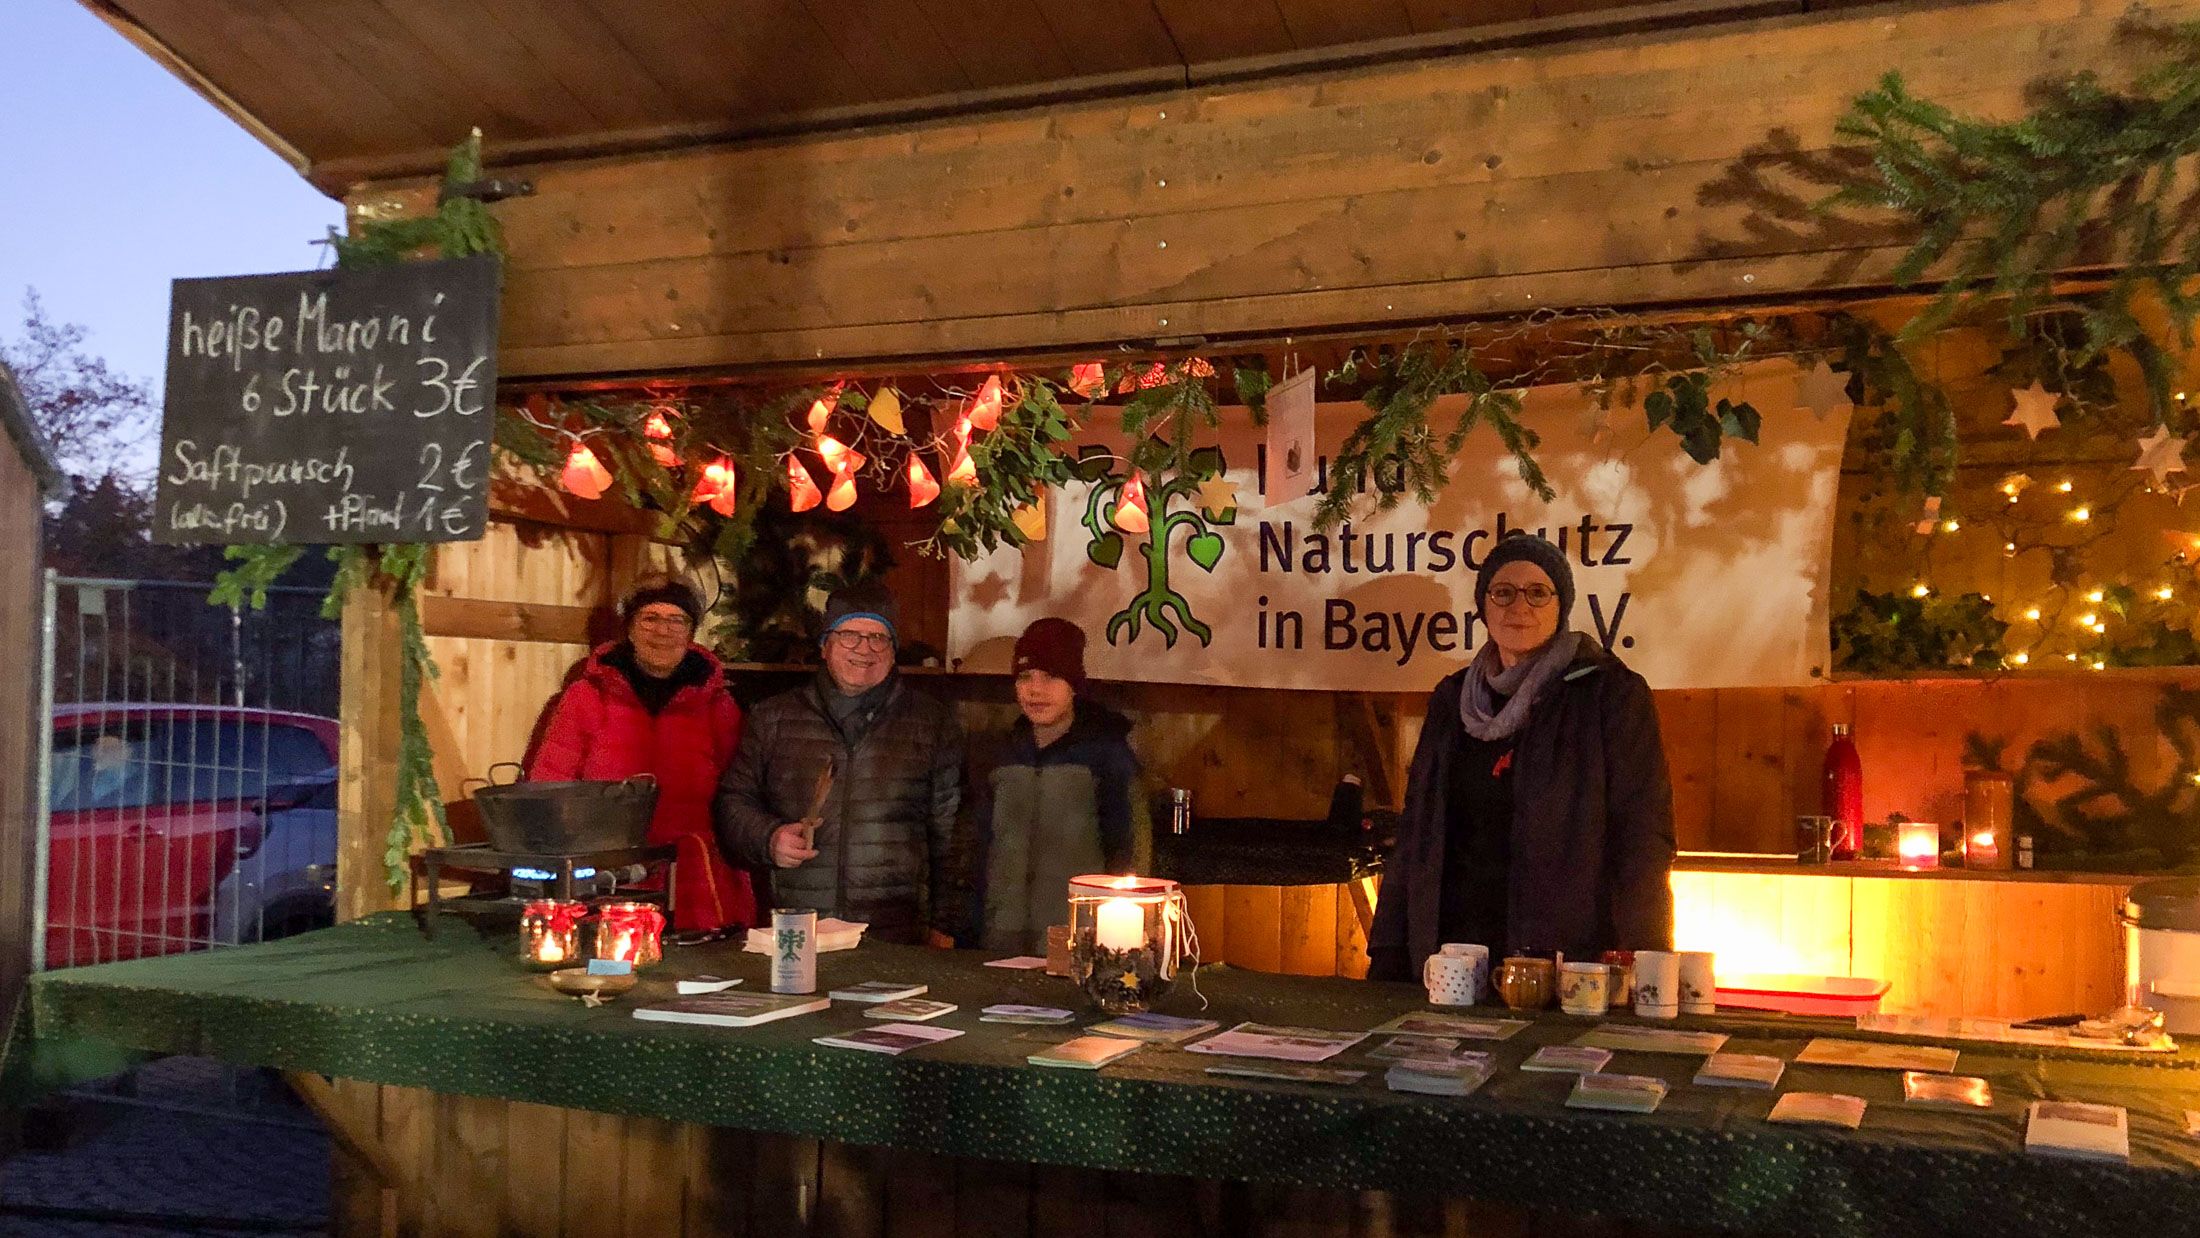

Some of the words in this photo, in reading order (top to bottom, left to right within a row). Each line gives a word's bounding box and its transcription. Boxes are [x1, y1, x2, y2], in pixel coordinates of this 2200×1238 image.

[182, 303, 284, 372] heiße
[296, 291, 446, 354] Maroni
[242, 374, 262, 413] 6
[273, 363, 397, 417] Stück
[1258, 595, 1303, 650] in
